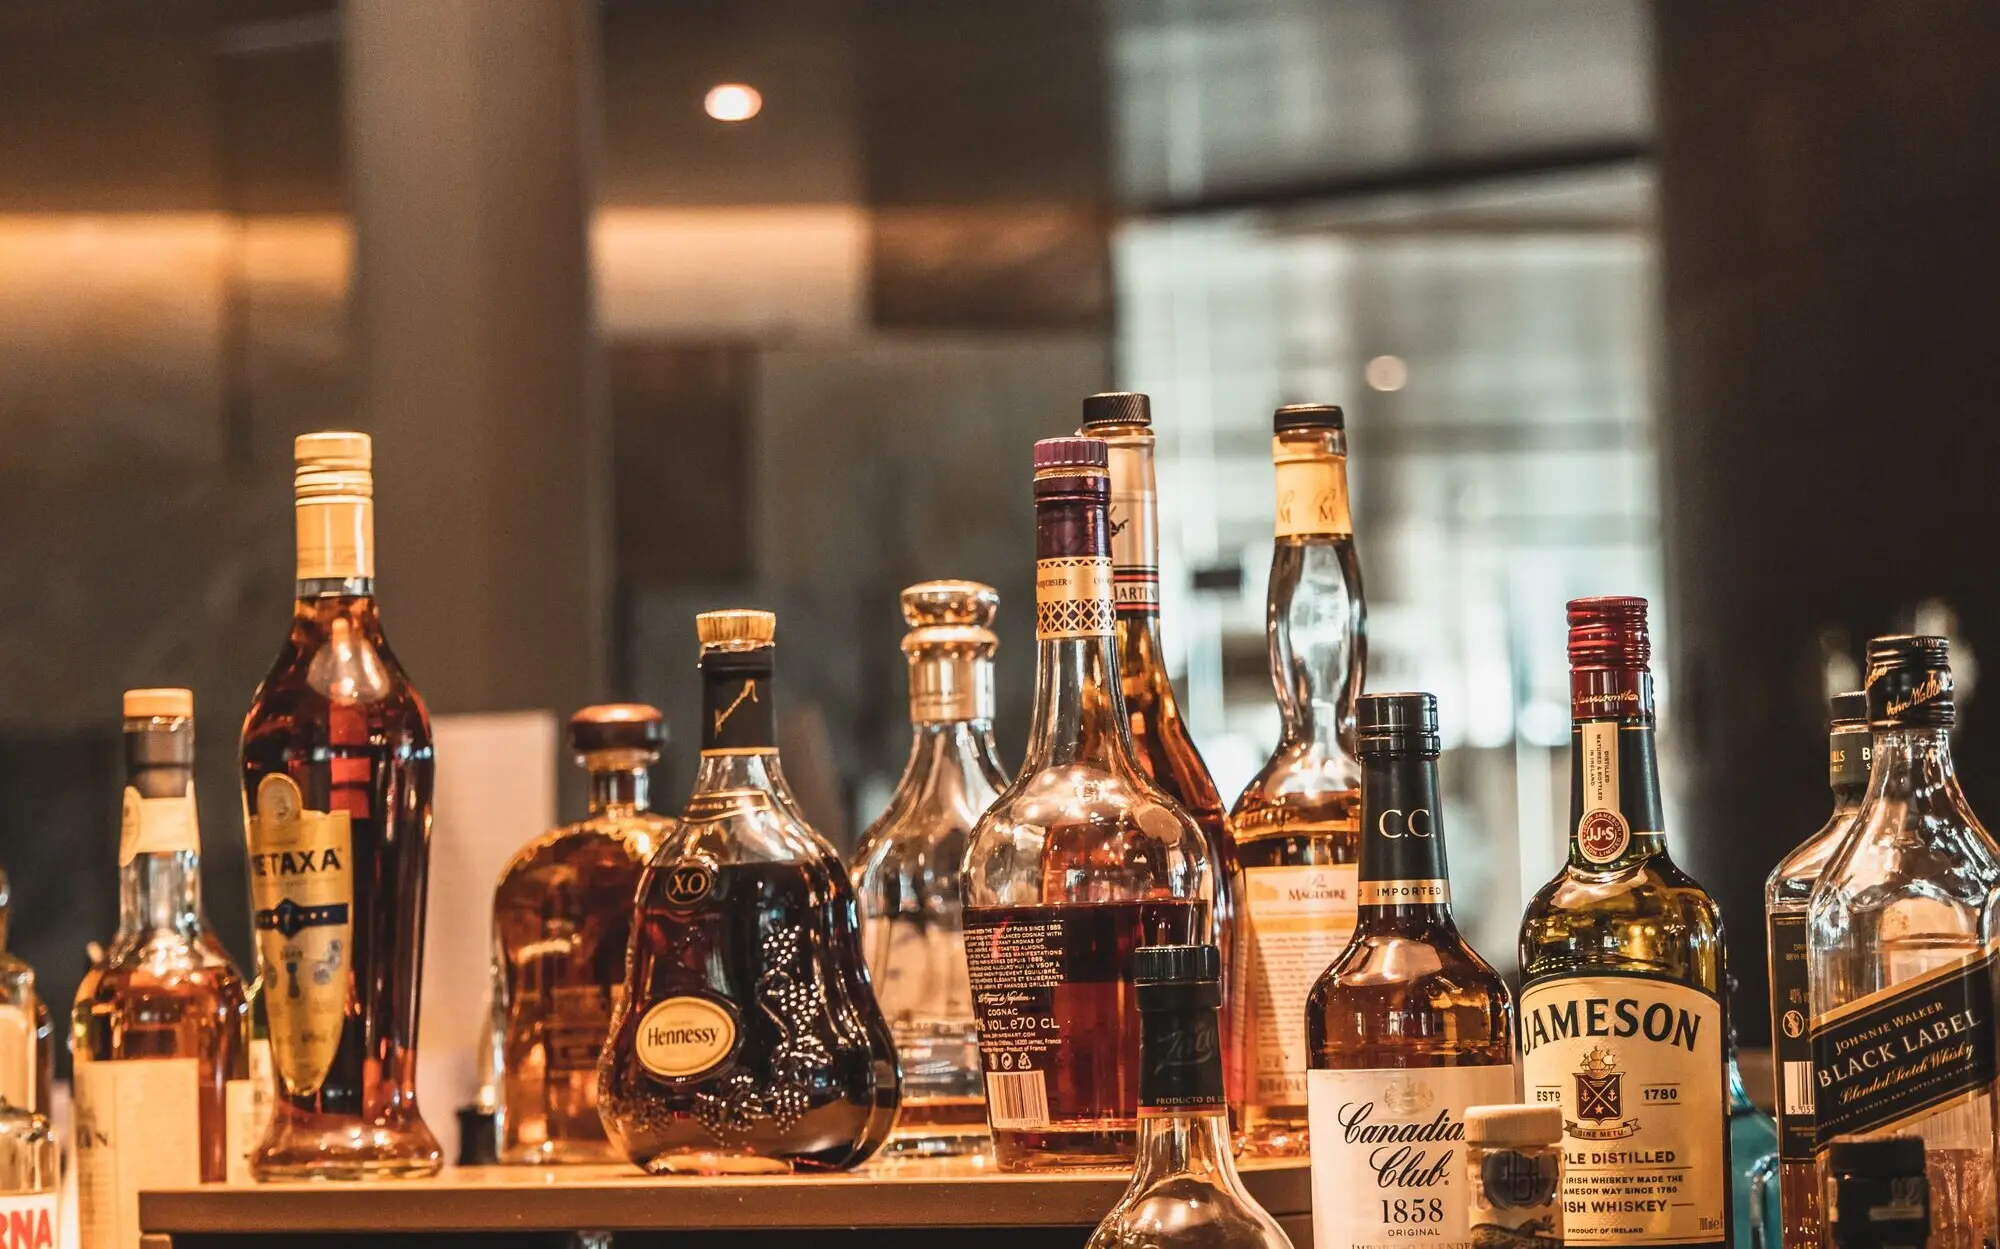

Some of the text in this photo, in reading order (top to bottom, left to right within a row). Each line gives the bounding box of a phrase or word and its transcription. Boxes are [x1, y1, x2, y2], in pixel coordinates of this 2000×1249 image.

[252, 849, 342, 876] ETAXA
[1376, 886, 1442, 897] IMPORTED
[987, 1008, 1018, 1017] COGNAC
[987, 1019, 1009, 1031] VOL.
[1040, 1018, 1060, 1029] CL
[1522, 998, 1702, 1056] JAMESON
[1835, 1001, 1944, 1057] JOHNNIE WALKER
[647, 1026, 718, 1047] Hennessy
[1817, 1008, 1982, 1089] BLACK LABEL
[1838, 1040, 1975, 1107] Blended Scotch Whisky
[1643, 1088, 1678, 1101] 1780
[1337, 1102, 1465, 1144] Canadia
[1600, 1129, 1624, 1138] METU
[1592, 1150, 1676, 1165] DISTILLED
[1591, 1176, 1634, 1184] WHISKEY
[1636, 1175, 1664, 1183] MADE
[1667, 1174, 1684, 1182] THE
[1563, 1185, 1678, 1195] AMESON WAY SINCE 1780
[1381, 1197, 1444, 1224] 1858
[1564, 1199, 1667, 1213] ISH WHISKEY
[1387, 1228, 1440, 1237] ORIGINAL
